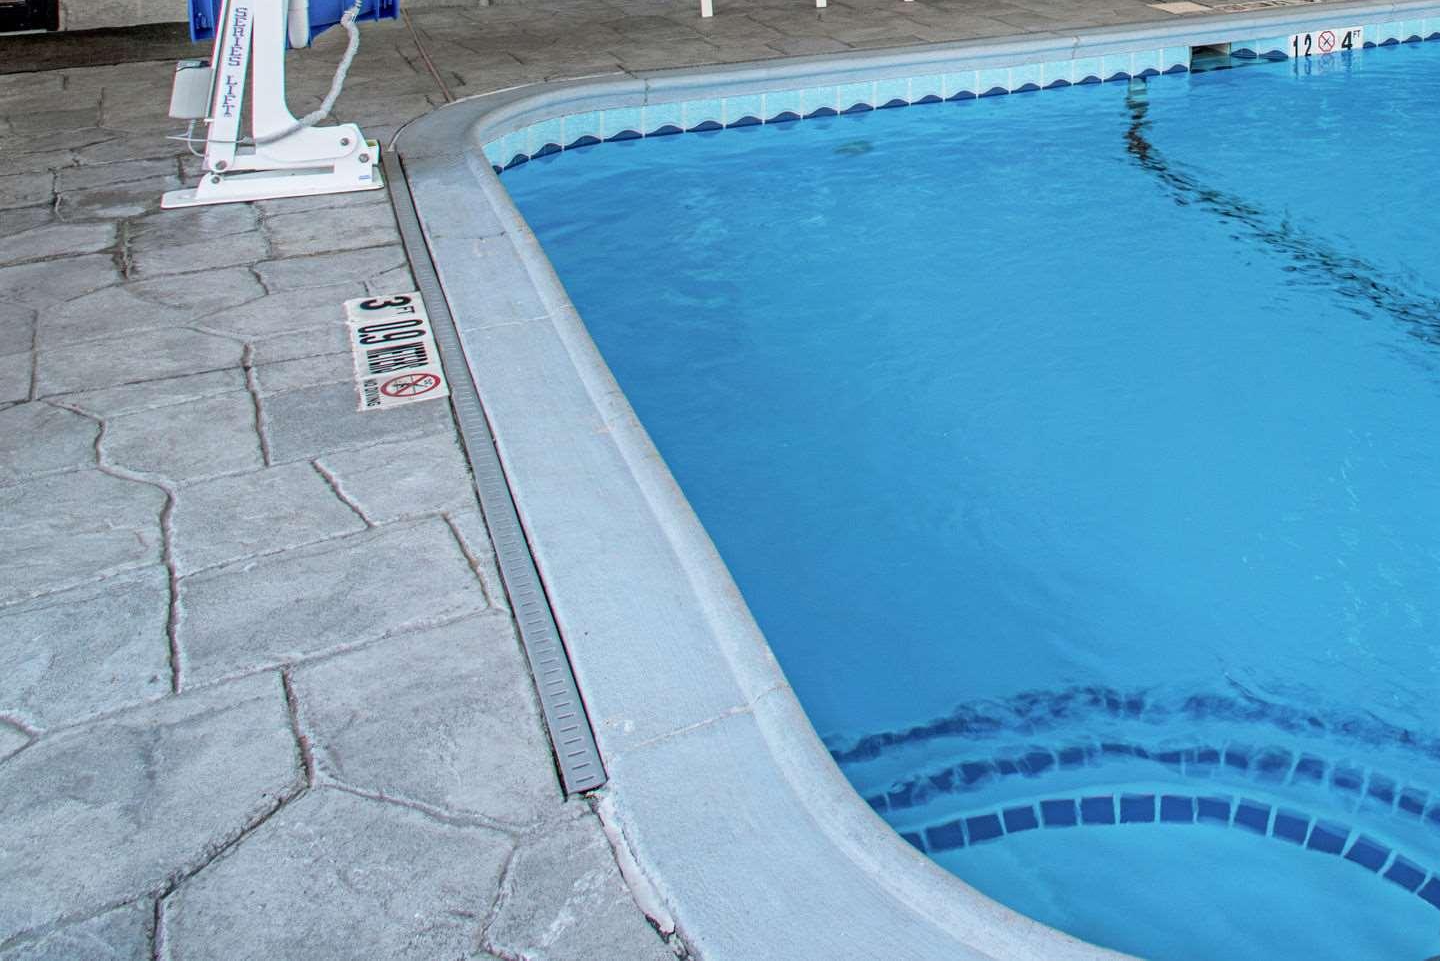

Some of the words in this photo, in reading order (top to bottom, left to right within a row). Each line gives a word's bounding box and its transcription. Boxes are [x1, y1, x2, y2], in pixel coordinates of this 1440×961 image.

[228, 6, 247, 67] SERIES
[1341, 30, 1353, 51] 4
[1353, 29, 1361, 38] FT
[222, 75, 238, 117] LIFT
[359, 296, 412, 311] 3
[366, 341, 430, 375] METERS
